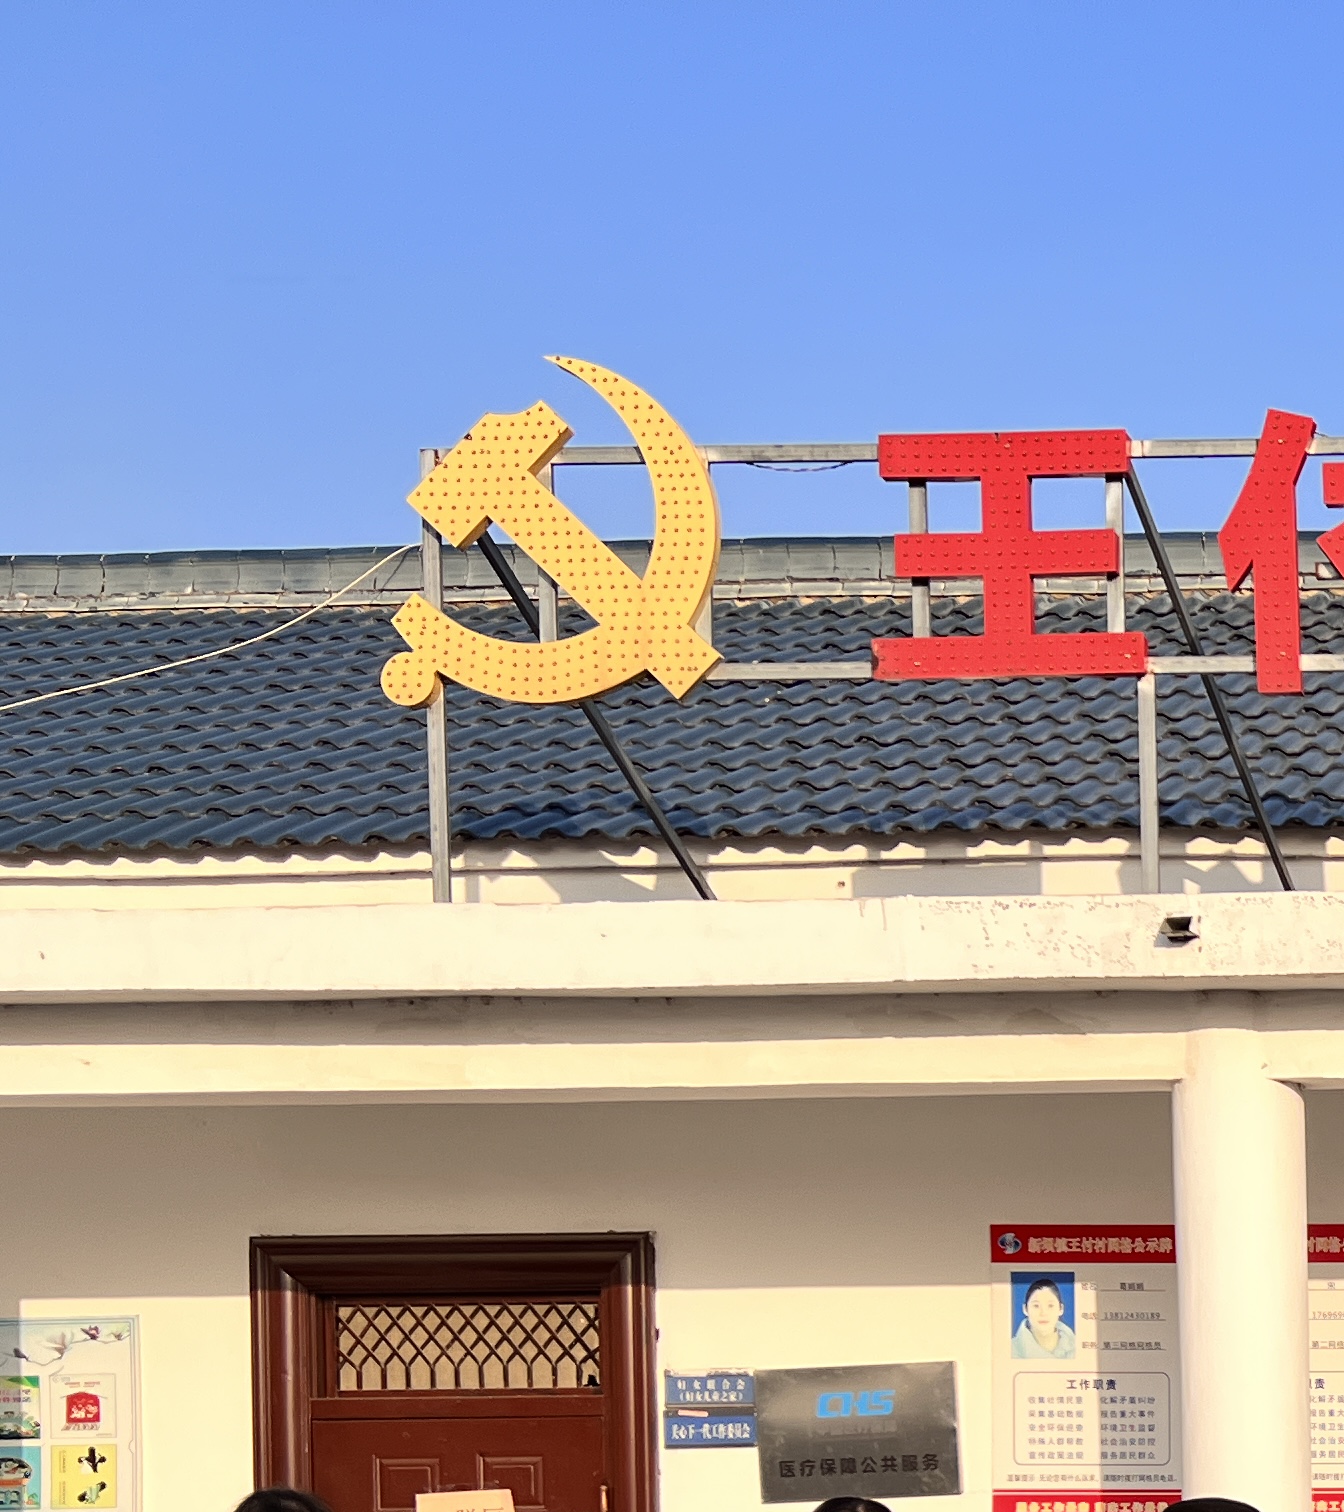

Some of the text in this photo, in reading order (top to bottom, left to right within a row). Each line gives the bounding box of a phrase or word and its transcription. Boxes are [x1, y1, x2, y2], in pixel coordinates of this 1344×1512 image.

[1066, 1379, 1117, 1390] 工作职责
[671, 1424, 751, 1439] 关心下一代工作委员会
[779, 1453, 939, 1478] 医疗保障公共服务
